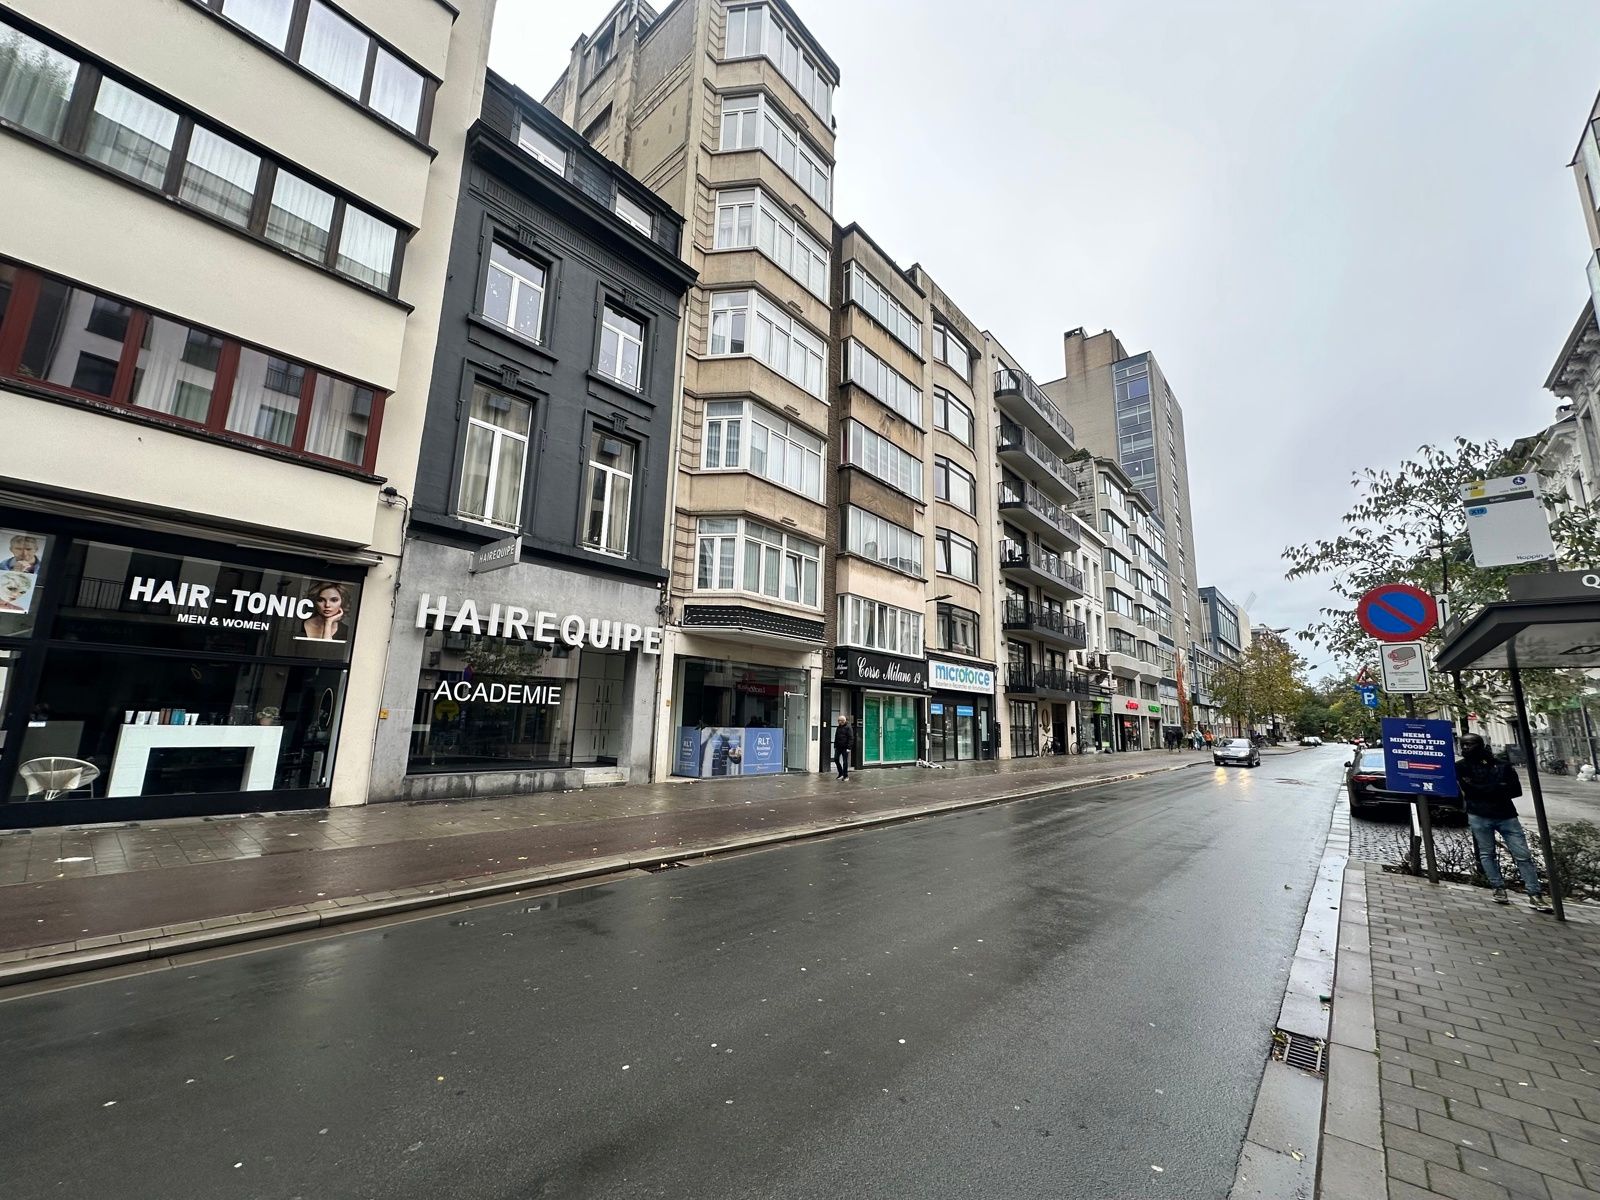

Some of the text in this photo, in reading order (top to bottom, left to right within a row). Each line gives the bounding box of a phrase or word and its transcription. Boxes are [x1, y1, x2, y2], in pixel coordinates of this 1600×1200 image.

[478, 544, 516, 564] HAIREQUIPE
[129, 576, 211, 609] HAIR
[231, 589, 315, 620] TONIC
[176, 613, 270, 631] MEN & WOMEN
[415, 592, 664, 655] HAIREQUIPE
[857, 656, 921, 684] Corso Milano 19
[935, 664, 990, 686] microforce
[433, 680, 562, 705] ACADEMIE
[1363, 692, 1375, 704] P
[757, 737, 770, 745] RLT
[1391, 748, 1446, 757] GEZONDHEID.
